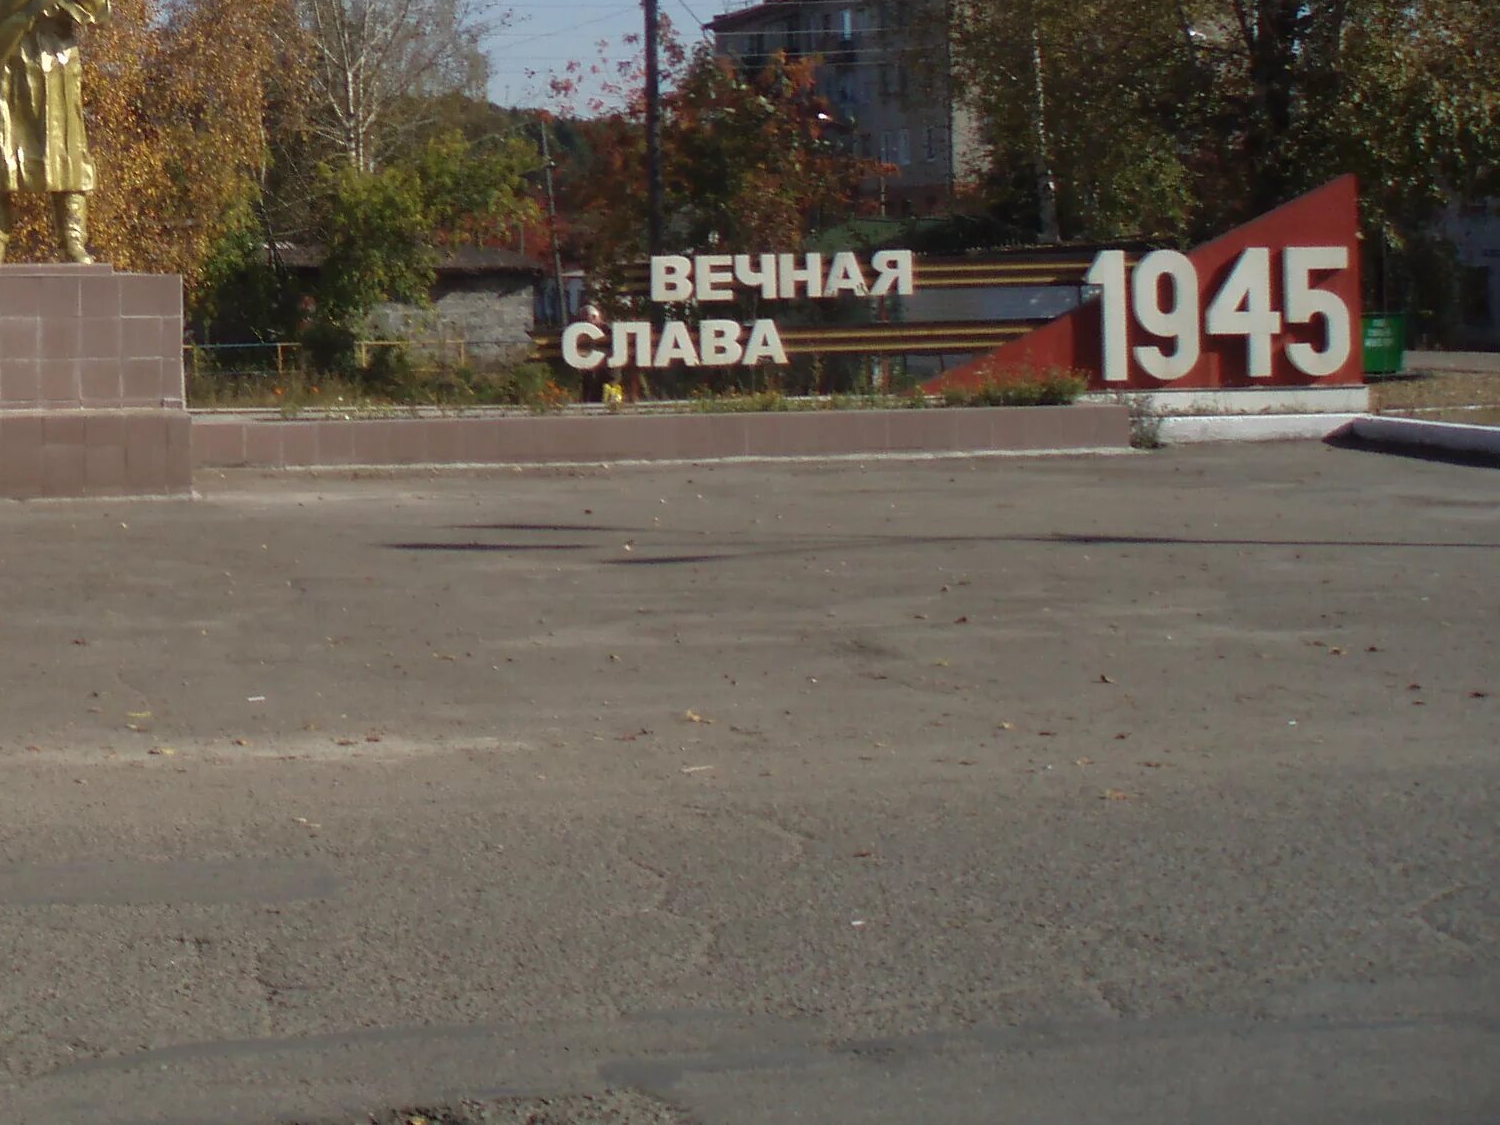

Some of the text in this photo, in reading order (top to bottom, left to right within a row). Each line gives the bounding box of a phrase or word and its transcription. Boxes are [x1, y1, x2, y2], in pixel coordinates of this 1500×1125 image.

[650, 249, 914, 302] ВЕЧНАЯ
[1086, 246, 1351, 382] 1945
[561, 319, 788, 369] СЛАВА
